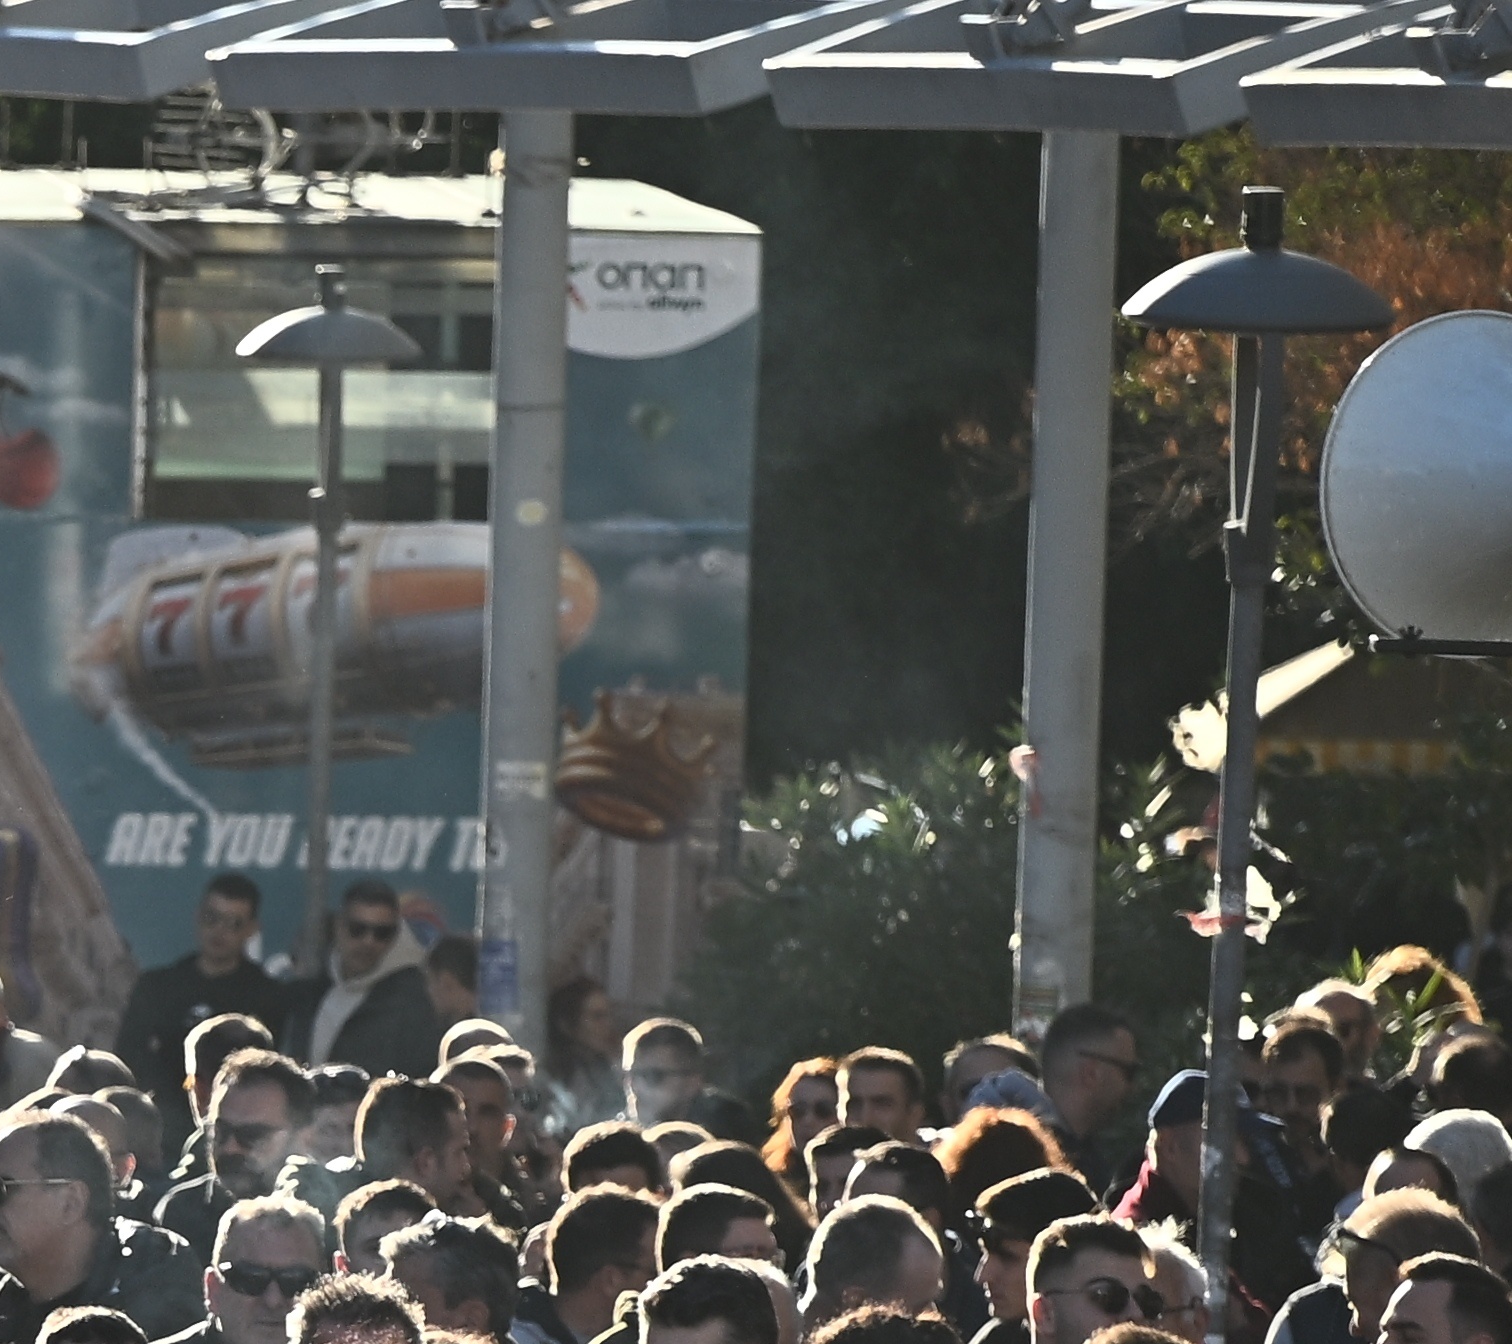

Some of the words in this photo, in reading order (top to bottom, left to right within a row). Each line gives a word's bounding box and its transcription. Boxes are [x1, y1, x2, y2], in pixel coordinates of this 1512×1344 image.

[105, 812, 198, 868] ARE
[202, 812, 294, 868] YOU
[298, 814, 443, 871] EADY
